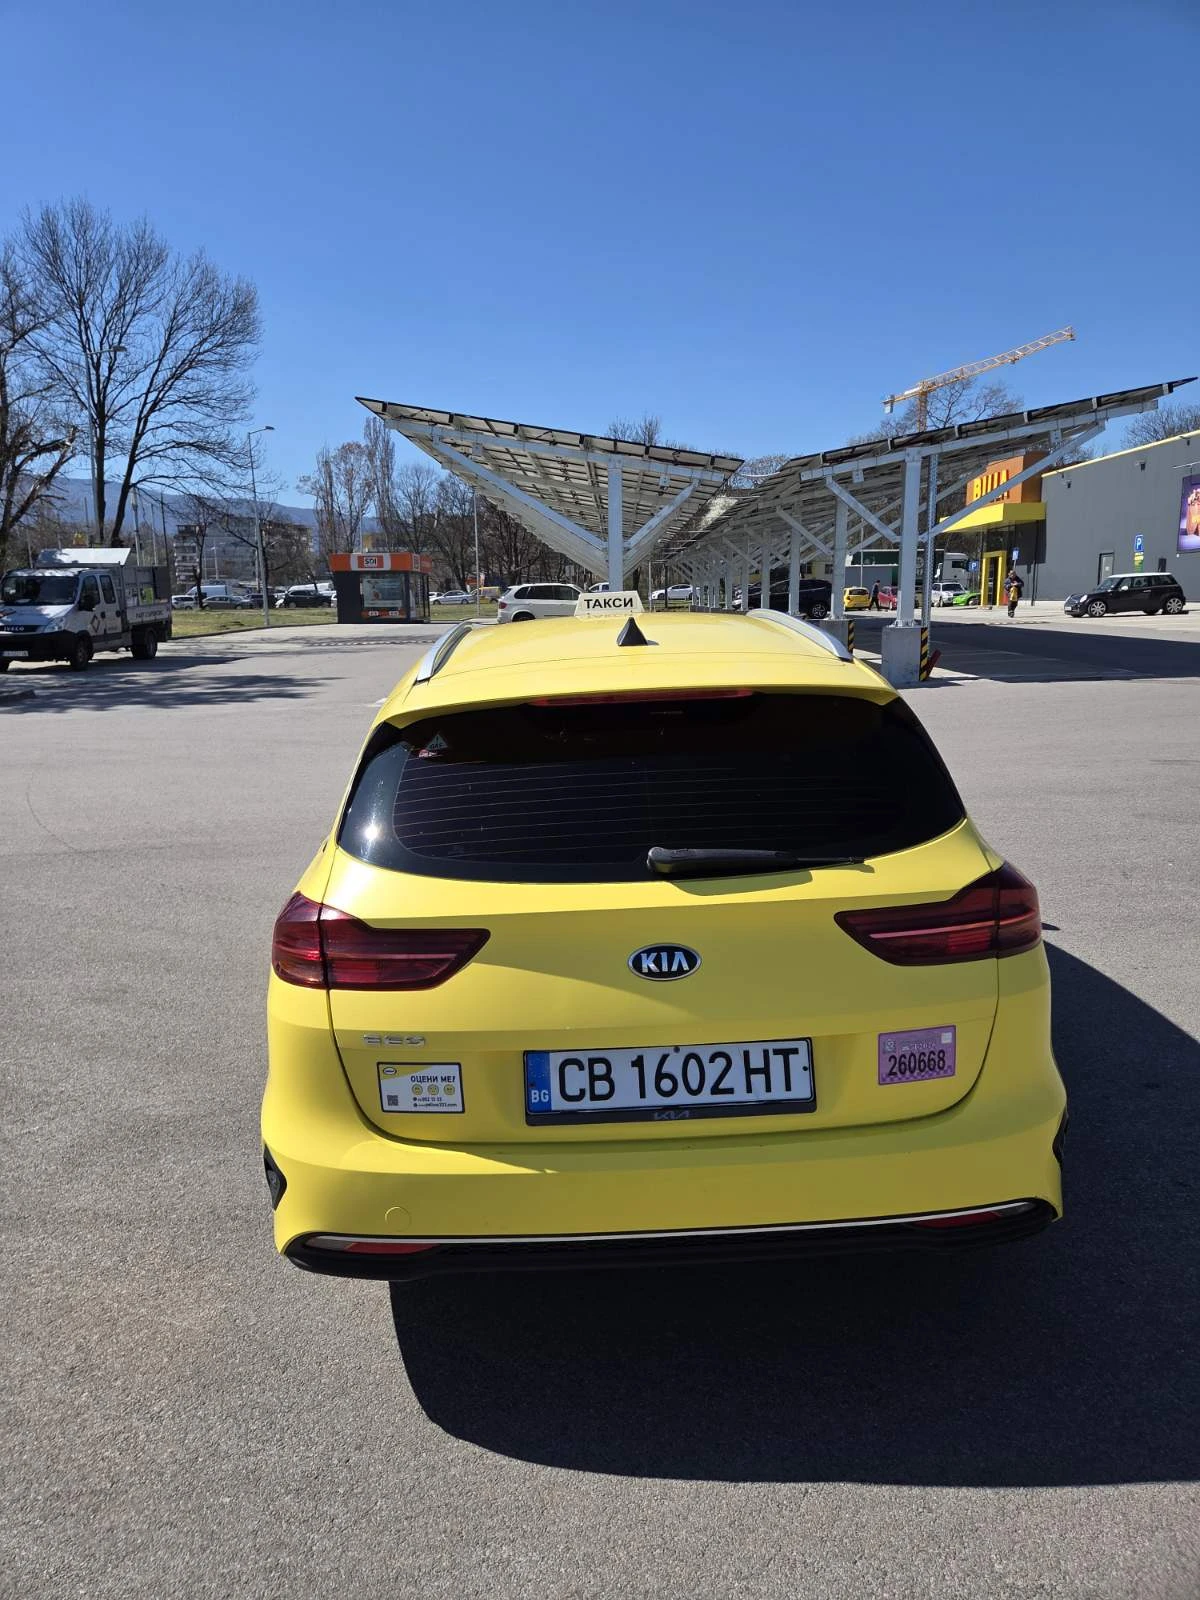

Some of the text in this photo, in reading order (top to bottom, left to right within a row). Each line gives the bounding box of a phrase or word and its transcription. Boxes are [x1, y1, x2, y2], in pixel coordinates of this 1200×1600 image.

[584, 597, 633, 609] ТАКСИ
[640, 951, 690, 973] KIA
[888, 1049, 946, 1077] 260668
[410, 1075, 438, 1084] ОЦЕНИ
[558, 1047, 800, 1103] CB 1602 HT
[531, 1089, 550, 1103] BG
